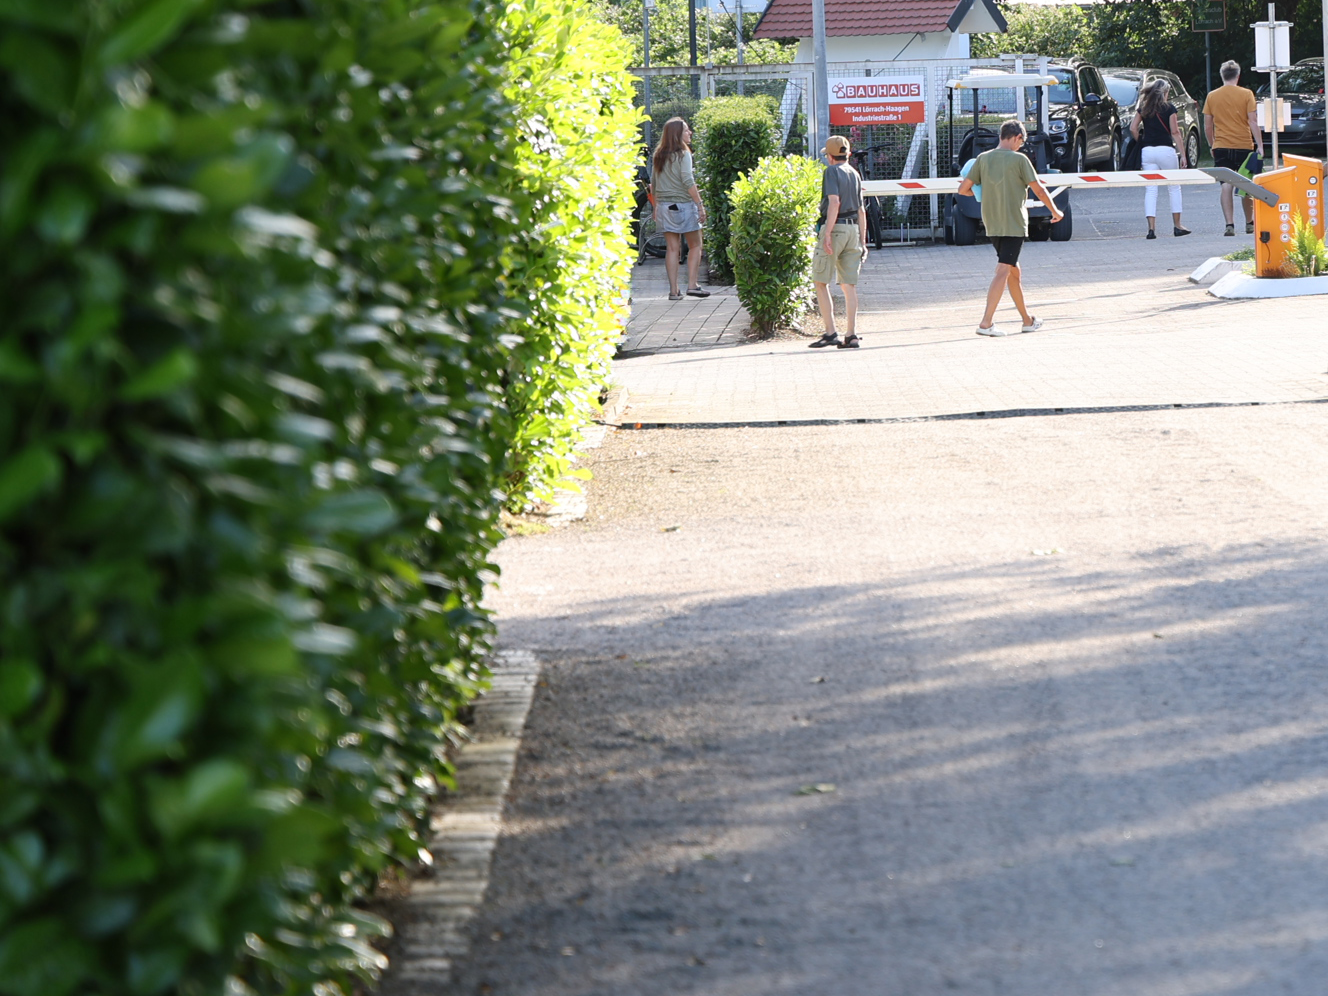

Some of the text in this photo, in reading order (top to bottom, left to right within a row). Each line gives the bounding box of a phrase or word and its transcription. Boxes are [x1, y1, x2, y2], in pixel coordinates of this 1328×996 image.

[846, 84, 920, 97] BAUHAUS
[863, 105, 909, 113] Lörrach-Haagen
[852, 114, 897, 122] Industriestraße
